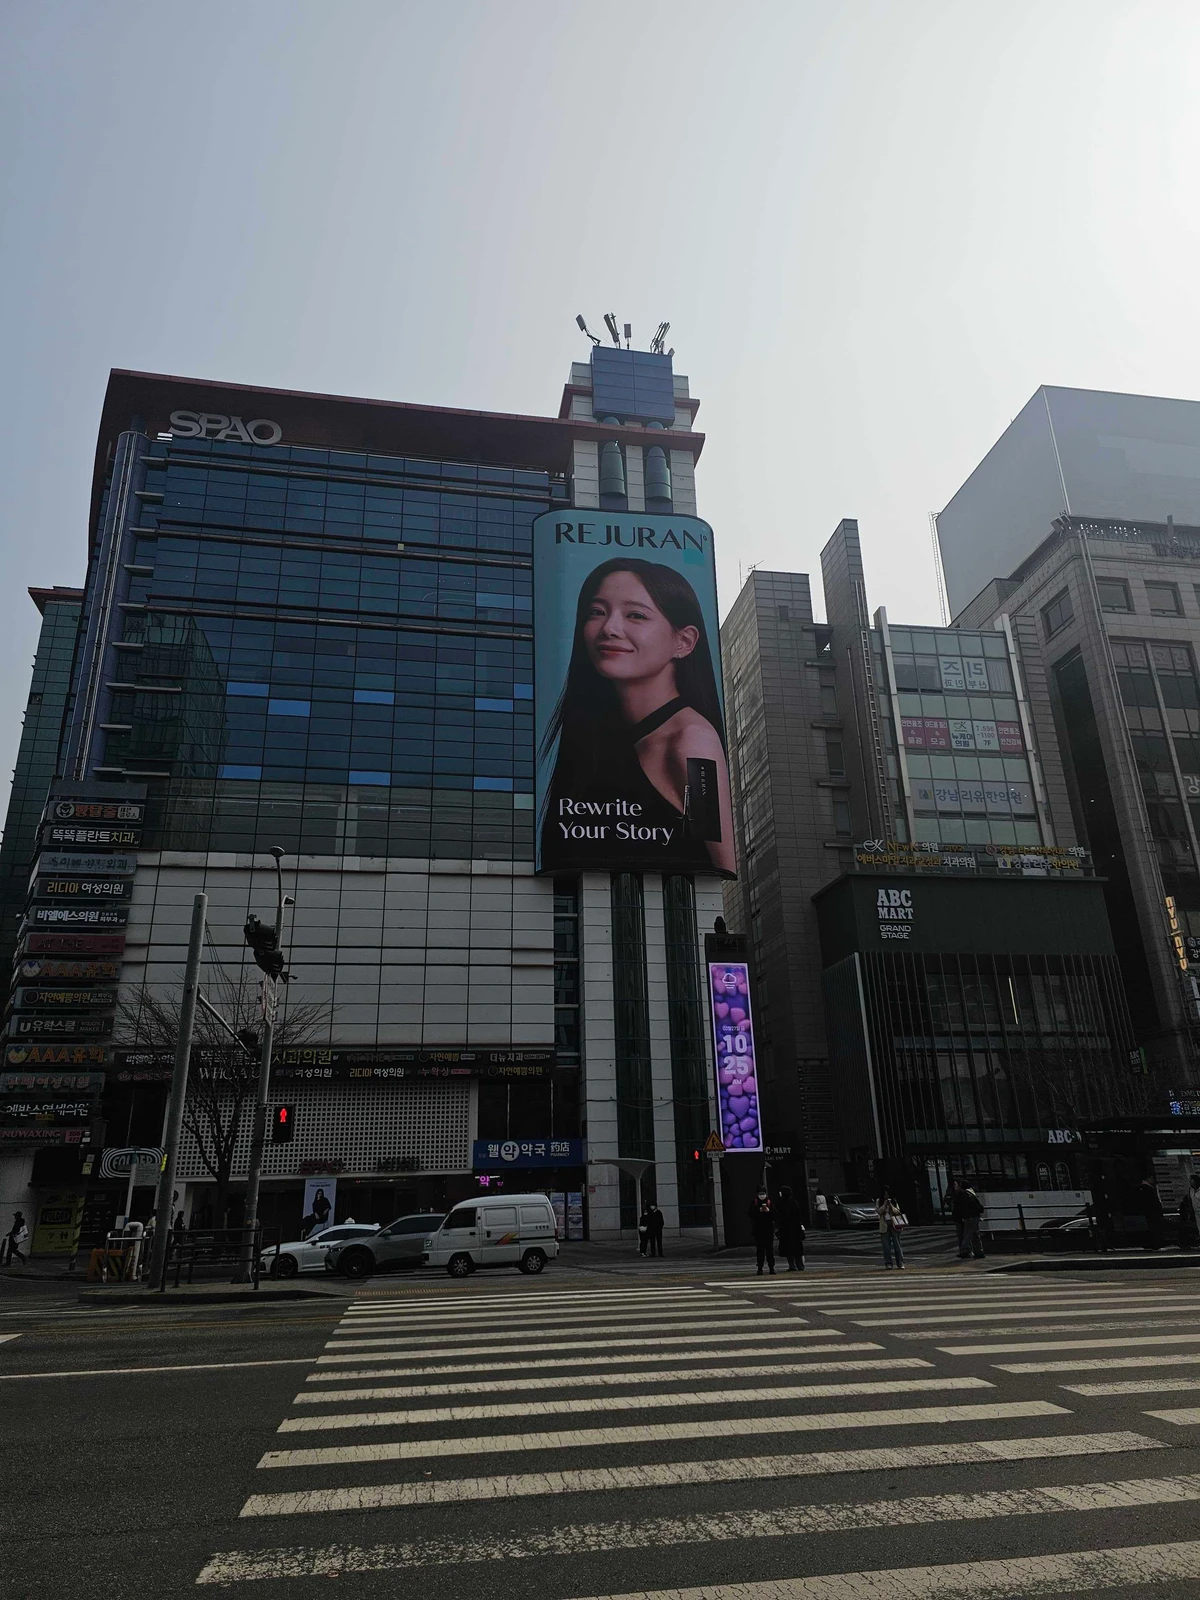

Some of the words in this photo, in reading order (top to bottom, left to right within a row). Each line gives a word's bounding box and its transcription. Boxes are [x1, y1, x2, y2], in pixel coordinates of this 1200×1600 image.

[168, 410, 282, 446] SPAO
[955, 740, 970, 748] 의원
[984, 739, 992, 747] 7F
[560, 798, 642, 817] Rewrite
[559, 821, 611, 840] Your
[615, 821, 674, 846] Story
[921, 842, 938, 852] 의원
[1068, 846, 1086, 858] 의원
[47, 882, 79, 894] 리디아
[81, 883, 124, 895] 여성의원
[877, 889, 912, 907] ABC
[37, 910, 99, 922] 비엘에스의원
[877, 907, 914, 919] MART
[881, 932, 909, 940] STAGE
[723, 1034, 748, 1053] 10
[723, 1055, 749, 1075] 25
[295, 1068, 332, 1078] 여성의원
[349, 1067, 373, 1078] 리디아
[374, 1067, 404, 1078] 여성의원
[2, 1129, 61, 1138] NUWAXING
[487, 1144, 499, 1158] 웰
[504, 1145, 517, 1159] 약
[521, 1143, 547, 1157] 약국
[550, 1142, 570, 1153] 药店
[480, 1175, 490, 1187] 약
